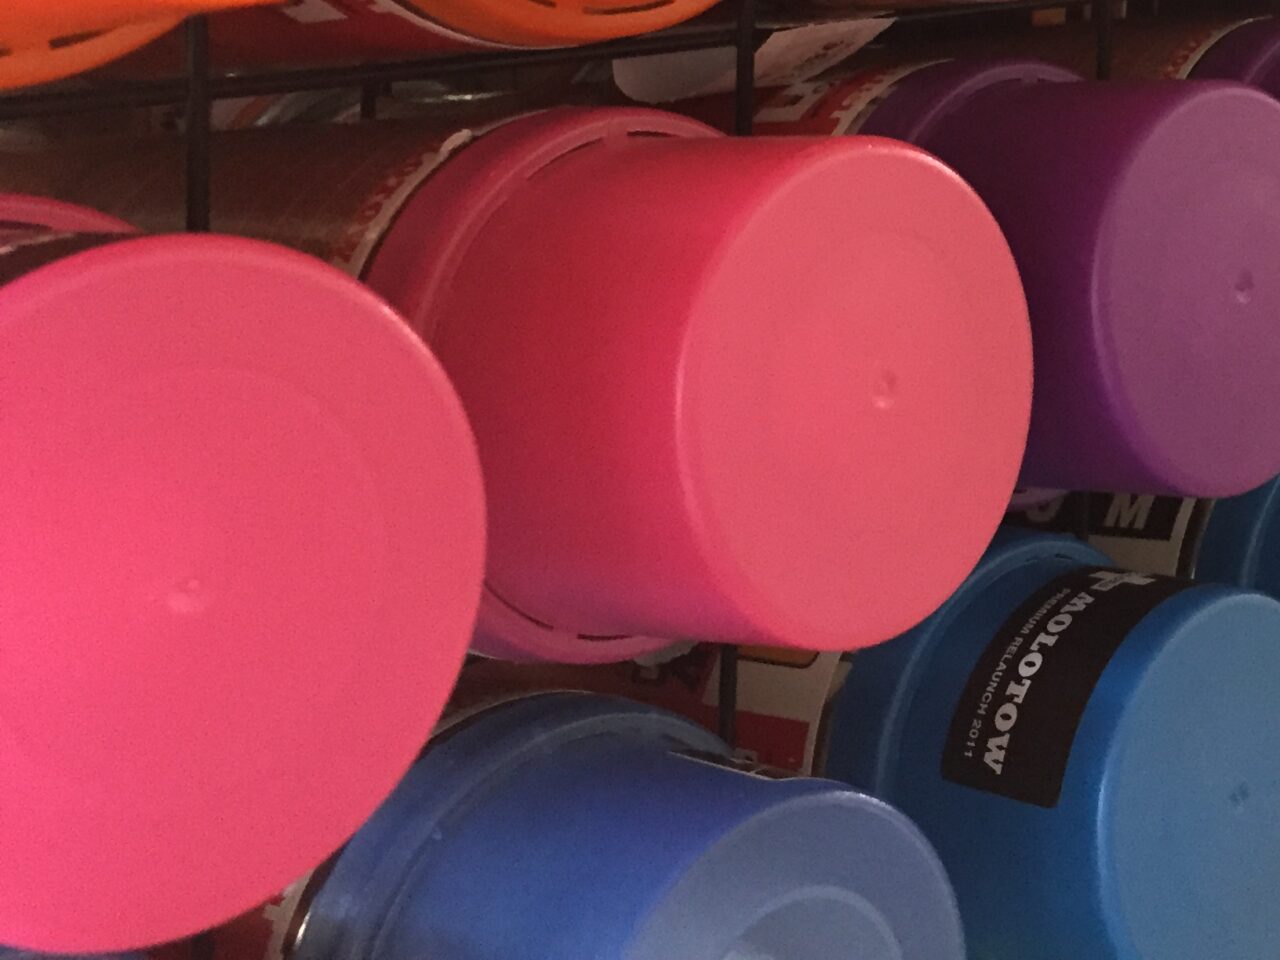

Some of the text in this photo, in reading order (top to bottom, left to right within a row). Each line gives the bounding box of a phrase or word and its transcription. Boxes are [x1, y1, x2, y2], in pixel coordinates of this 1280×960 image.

[976, 636, 1024, 716] RELAUNCH
[982, 591, 1096, 776] MOLOTOW
[963, 718, 983, 759] 2011
